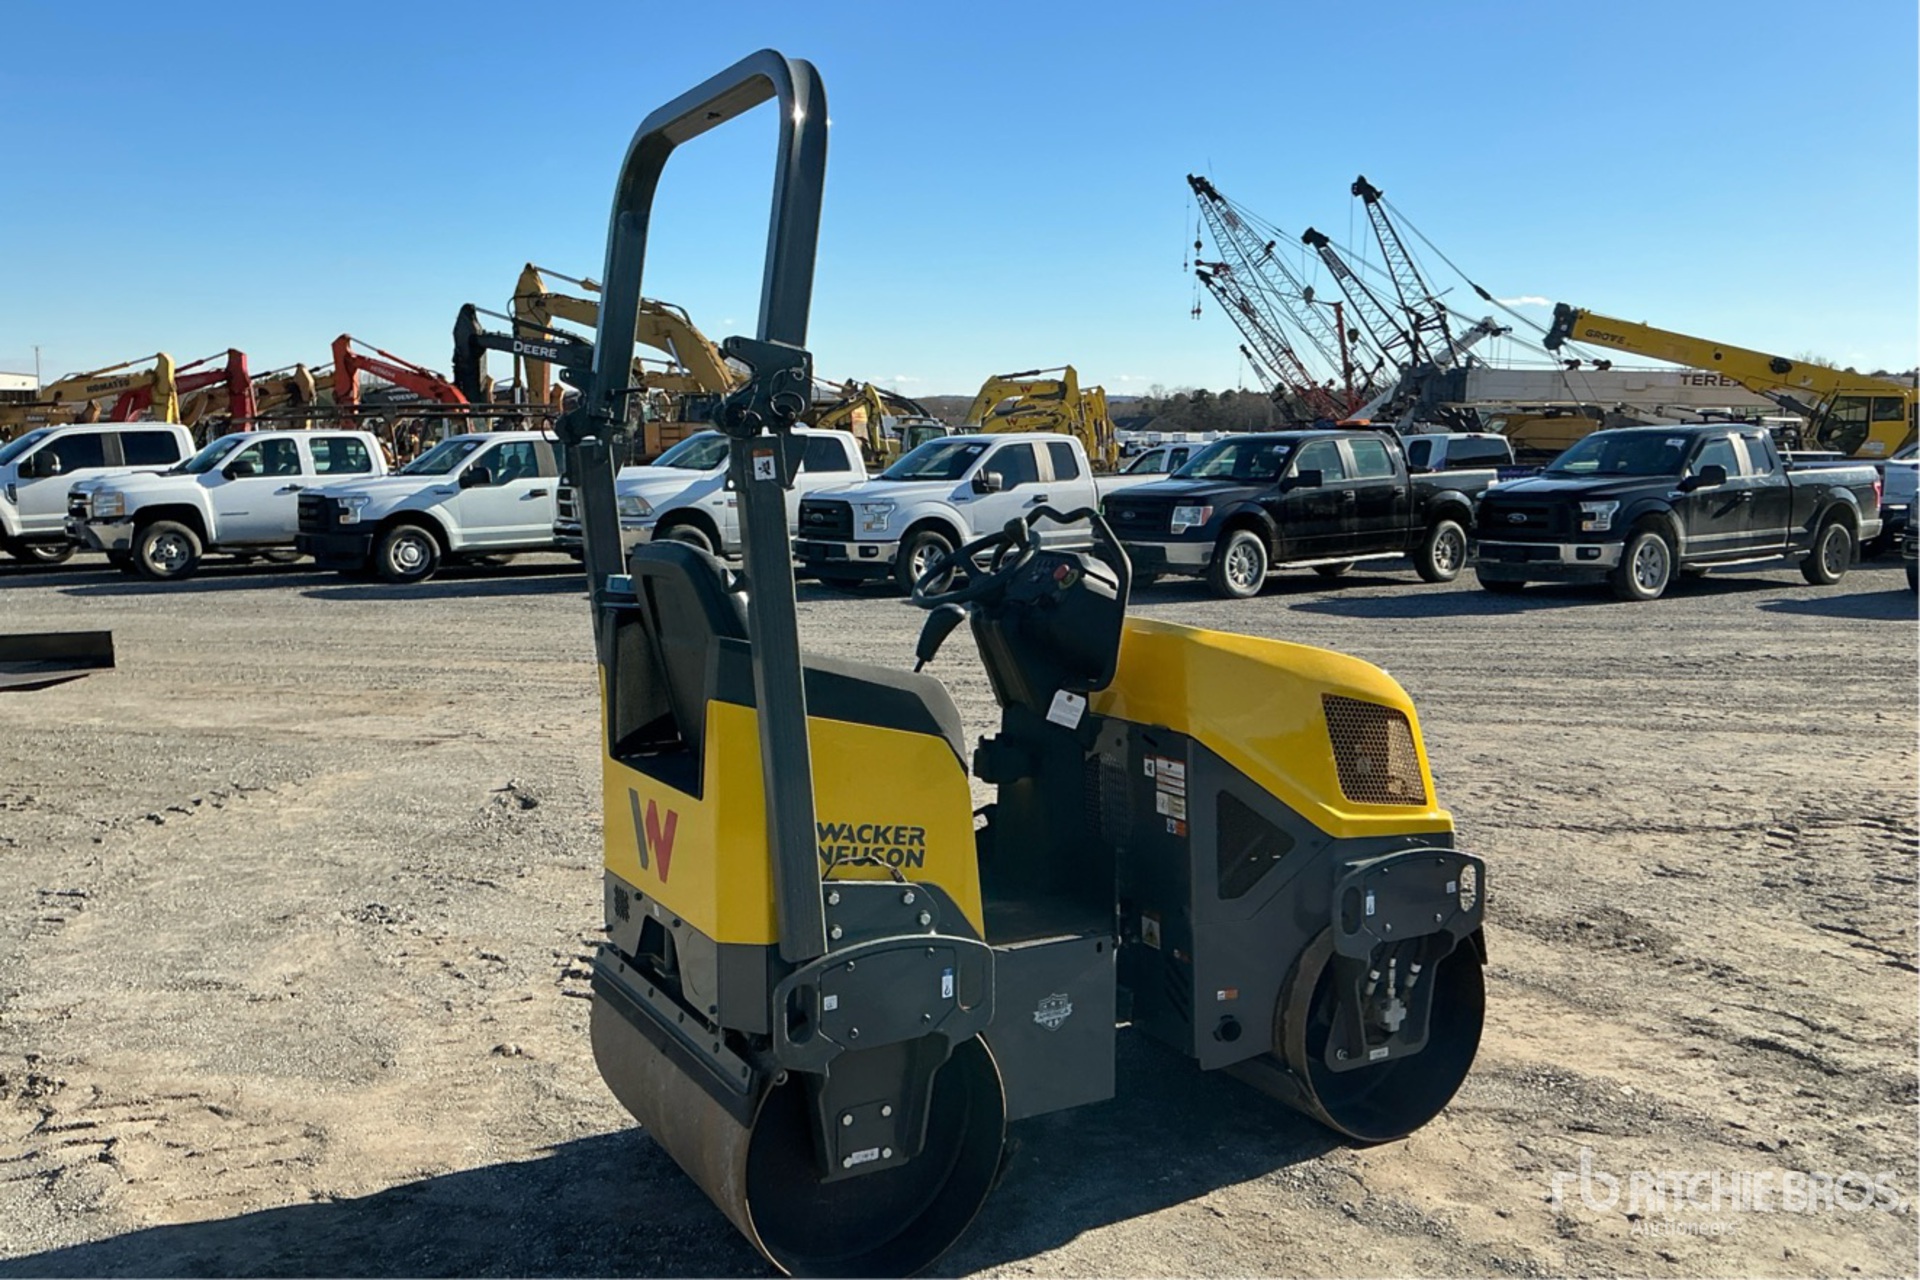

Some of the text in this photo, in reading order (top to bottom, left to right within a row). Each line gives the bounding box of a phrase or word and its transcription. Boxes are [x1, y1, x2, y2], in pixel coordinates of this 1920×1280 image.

[1585, 328, 1626, 345] GROVE
[513, 340, 558, 359] DEERE
[816, 822, 926, 847] WACKER
[817, 845, 926, 869] NEUSON
